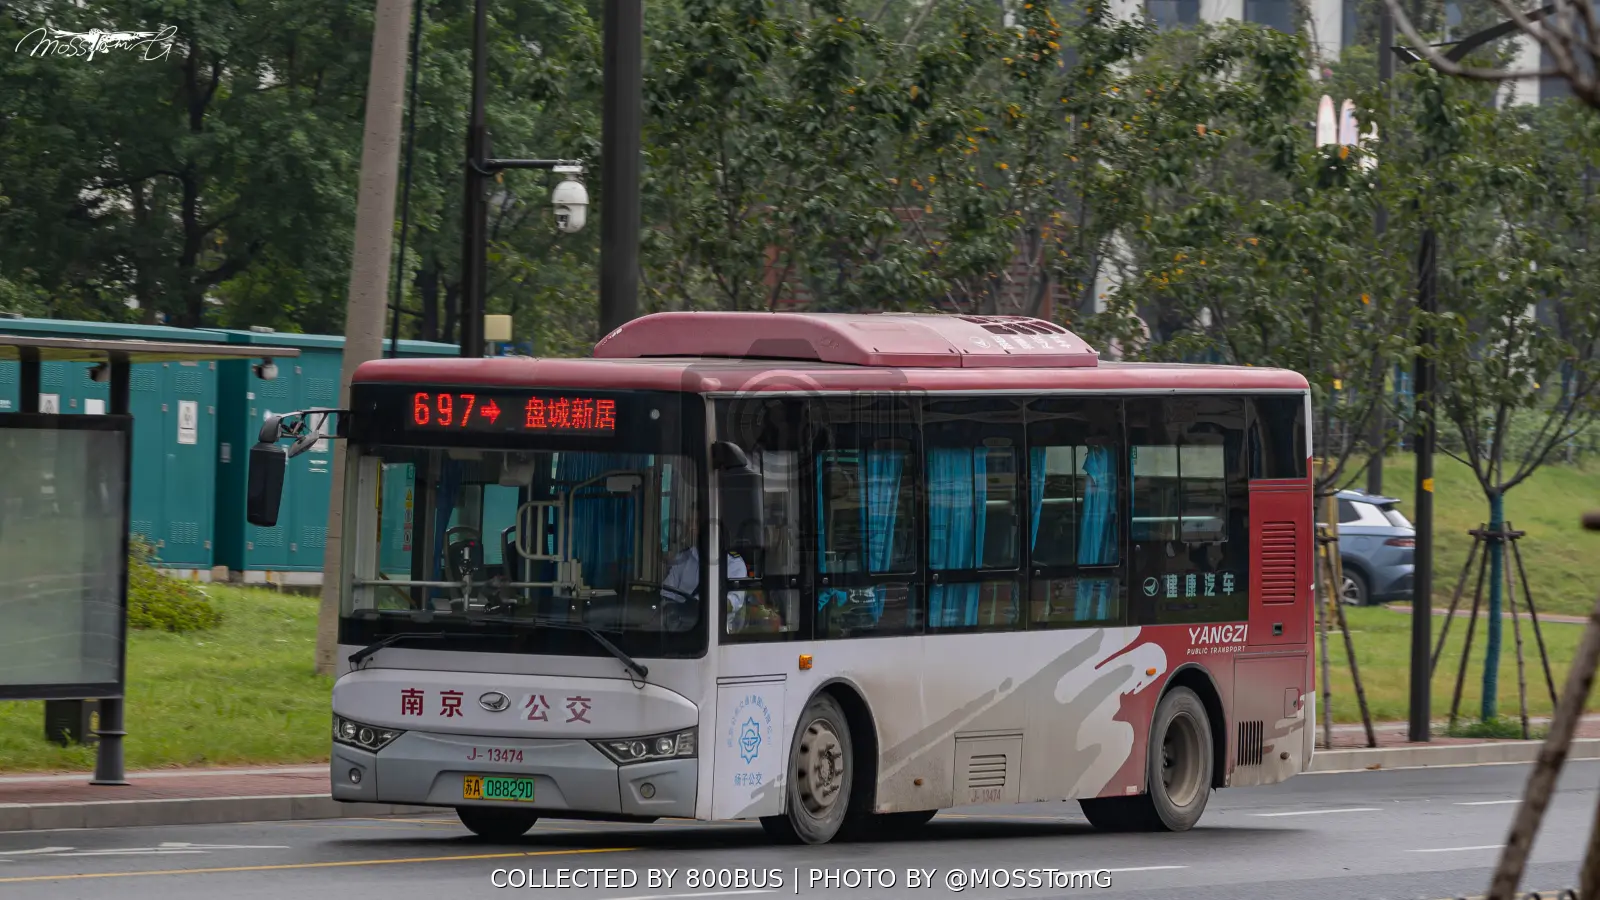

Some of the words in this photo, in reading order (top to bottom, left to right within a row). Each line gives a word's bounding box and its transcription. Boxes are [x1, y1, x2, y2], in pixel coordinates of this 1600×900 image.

[413, 392, 476, 427] 697
[525, 396, 616, 430] 盘城新居
[1189, 624, 1249, 645] YANGZI
[1187, 647, 1208, 656] PUBLIC
[1210, 645, 1246, 655] TRANSPORT
[401, 688, 464, 718] 南京
[525, 694, 592, 724] 公交
